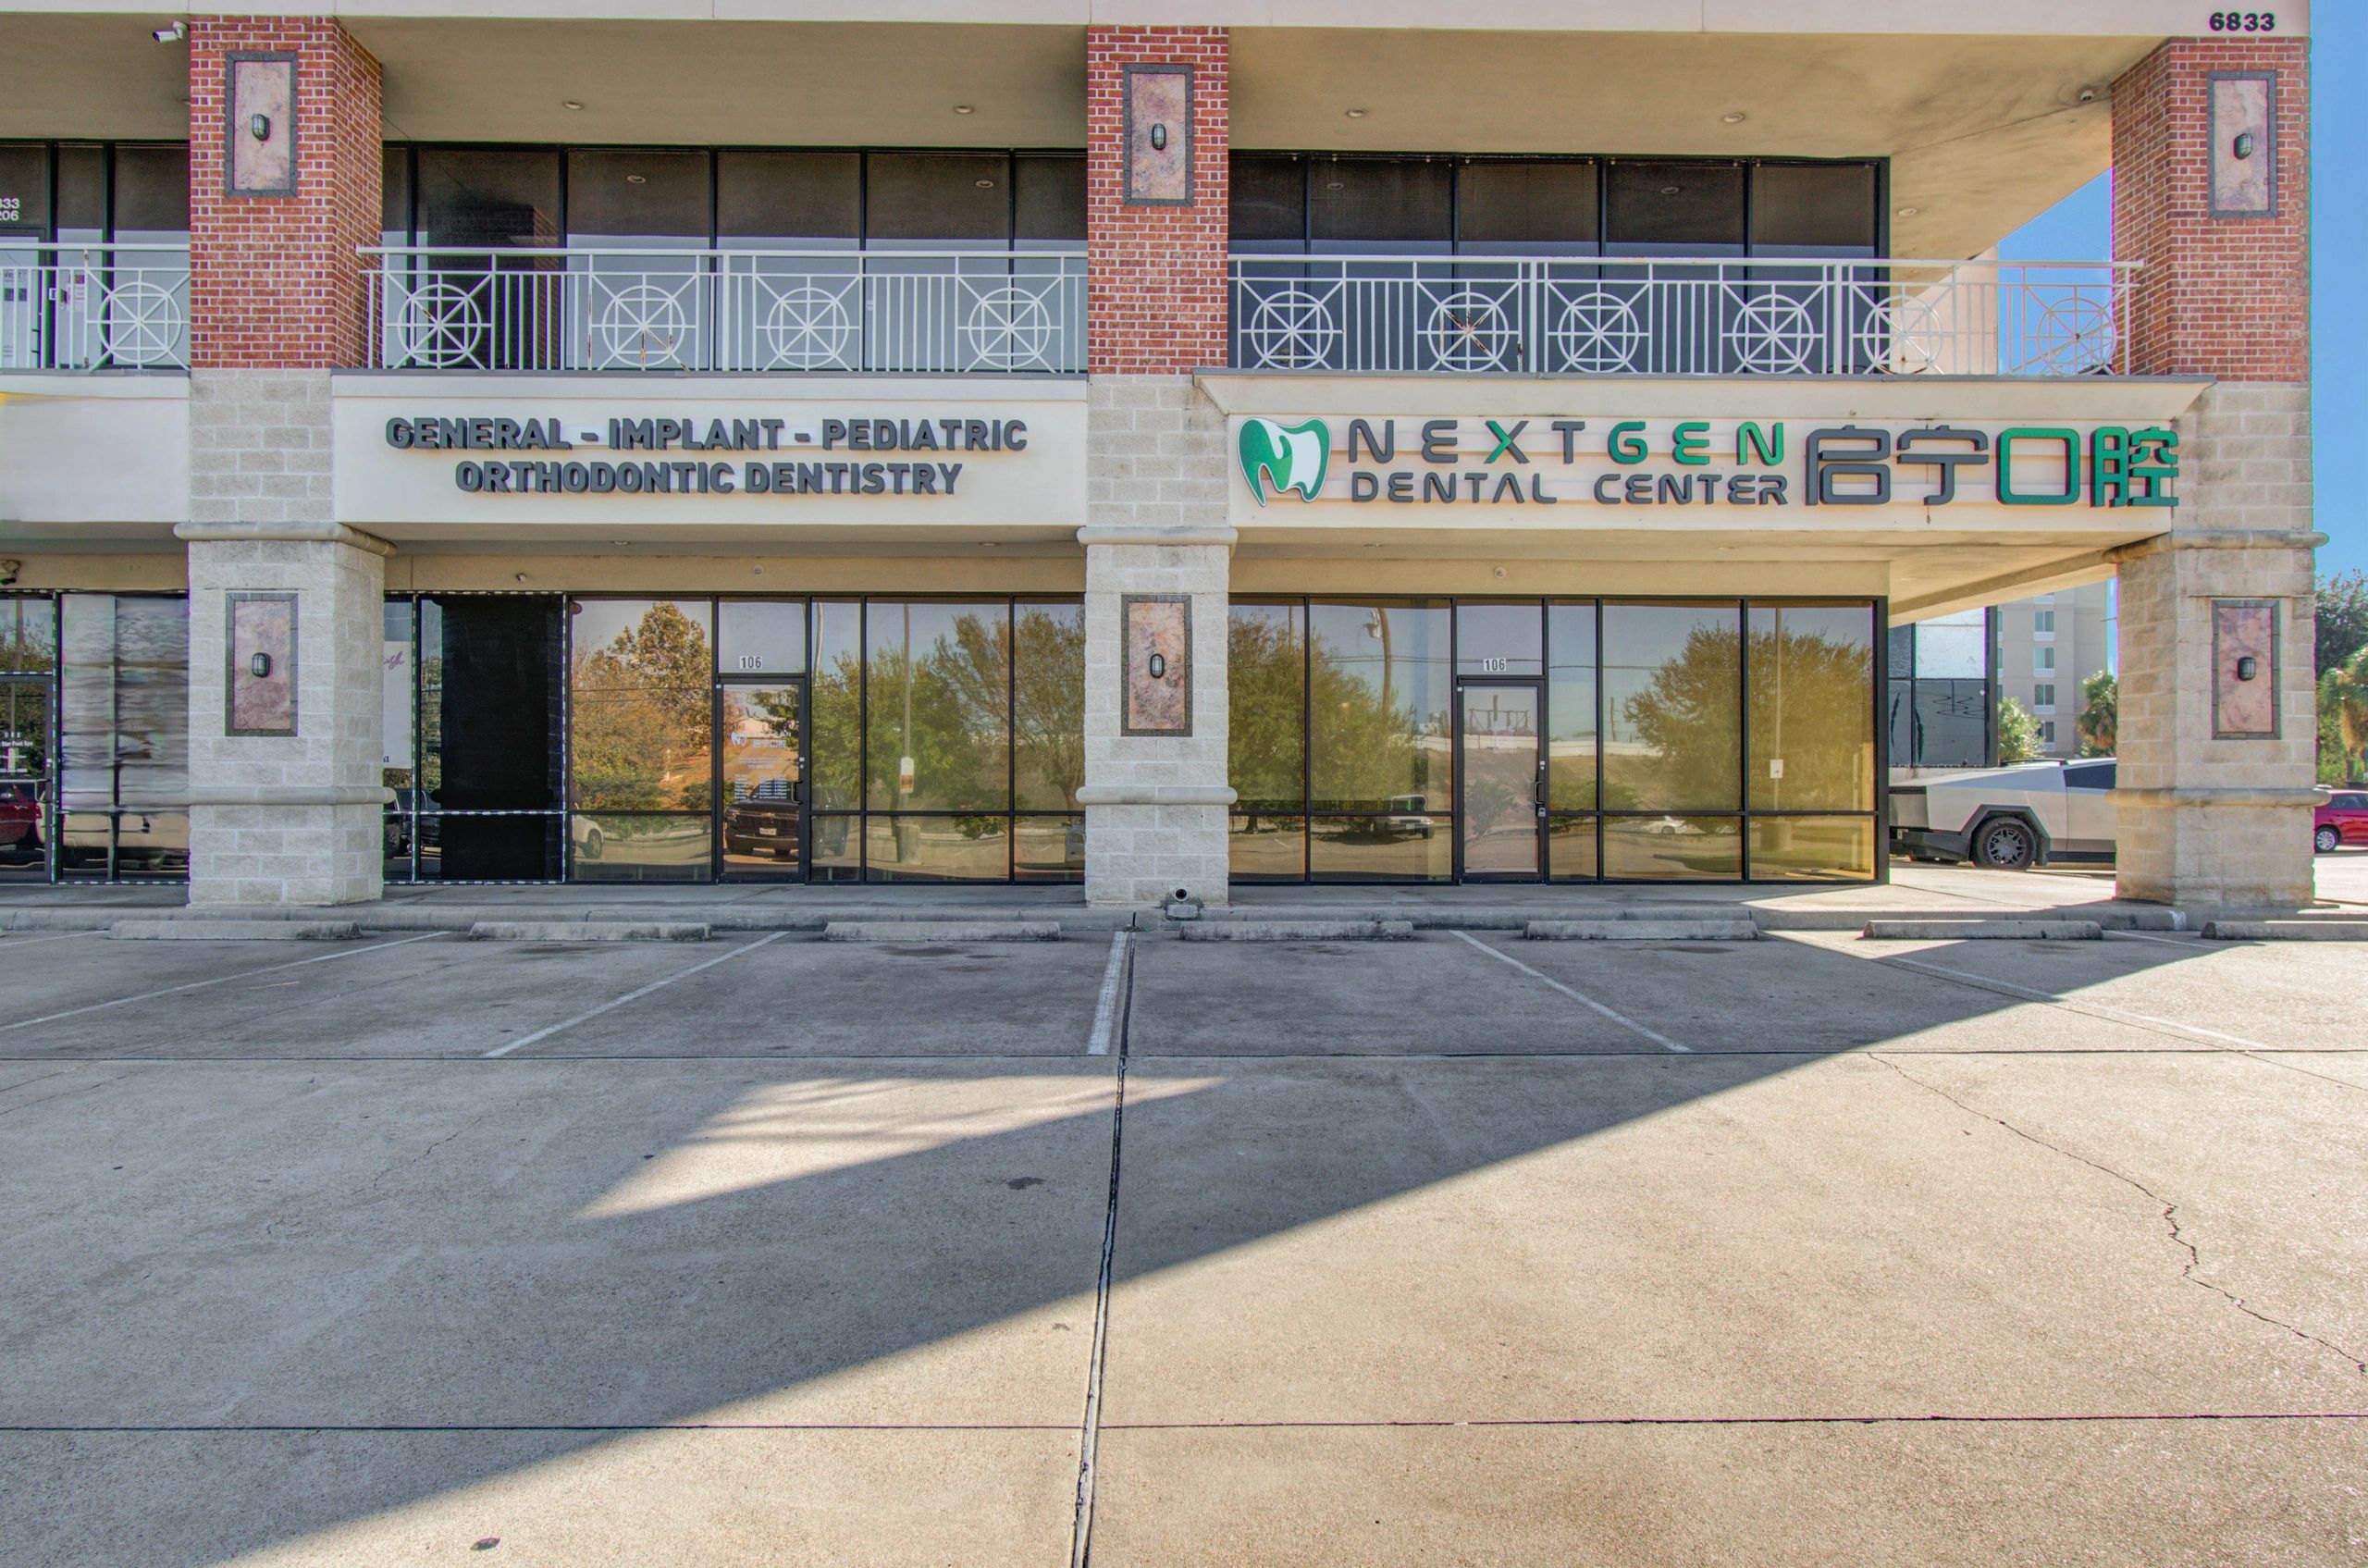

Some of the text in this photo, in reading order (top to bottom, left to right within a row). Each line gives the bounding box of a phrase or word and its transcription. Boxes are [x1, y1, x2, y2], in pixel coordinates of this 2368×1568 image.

[2209, 12, 2276, 31] 6833
[0, 198, 19, 209] 33
[0, 210, 18, 221] 06
[386, 417, 572, 451] GENERAL
[608, 418, 785, 451] IMPLANT
[821, 419, 1027, 451] PEDIATRIC
[1348, 418, 1785, 465] NEXTGEN
[455, 461, 962, 494] ORTHODONTIC DENTISTRY
[1351, 472, 1788, 506] DENTAL CENTER
[741, 656, 762, 669] 106
[1485, 659, 1505, 671] 106
